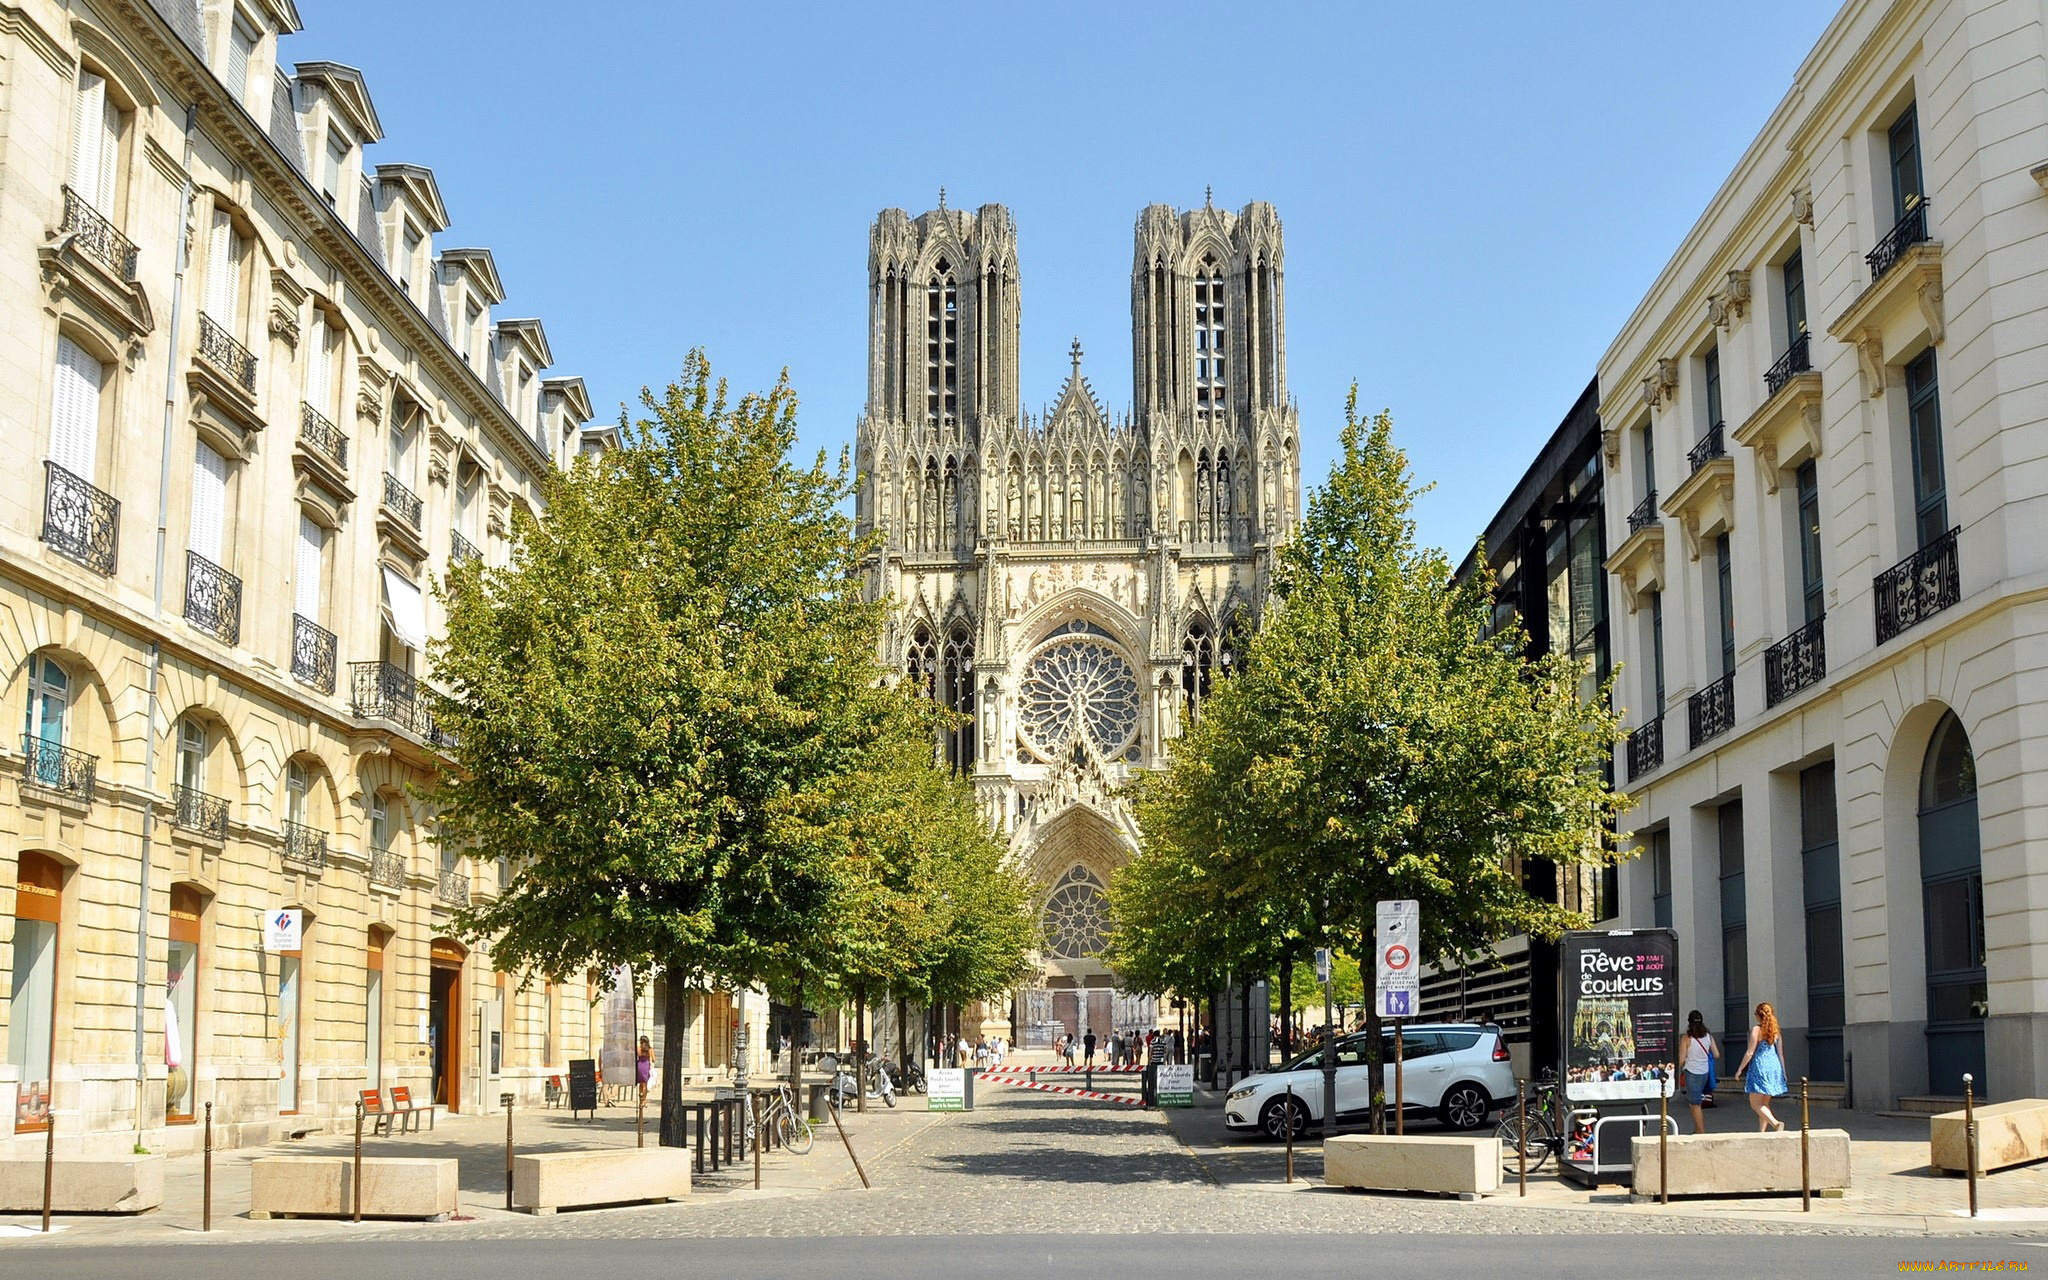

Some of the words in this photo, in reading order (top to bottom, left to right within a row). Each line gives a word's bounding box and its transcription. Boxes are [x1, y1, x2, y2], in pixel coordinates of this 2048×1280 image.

[1580, 952, 1634, 973] Rêve
[1580, 974, 1664, 994] couleurs
[1581, 972, 1592, 980] de
